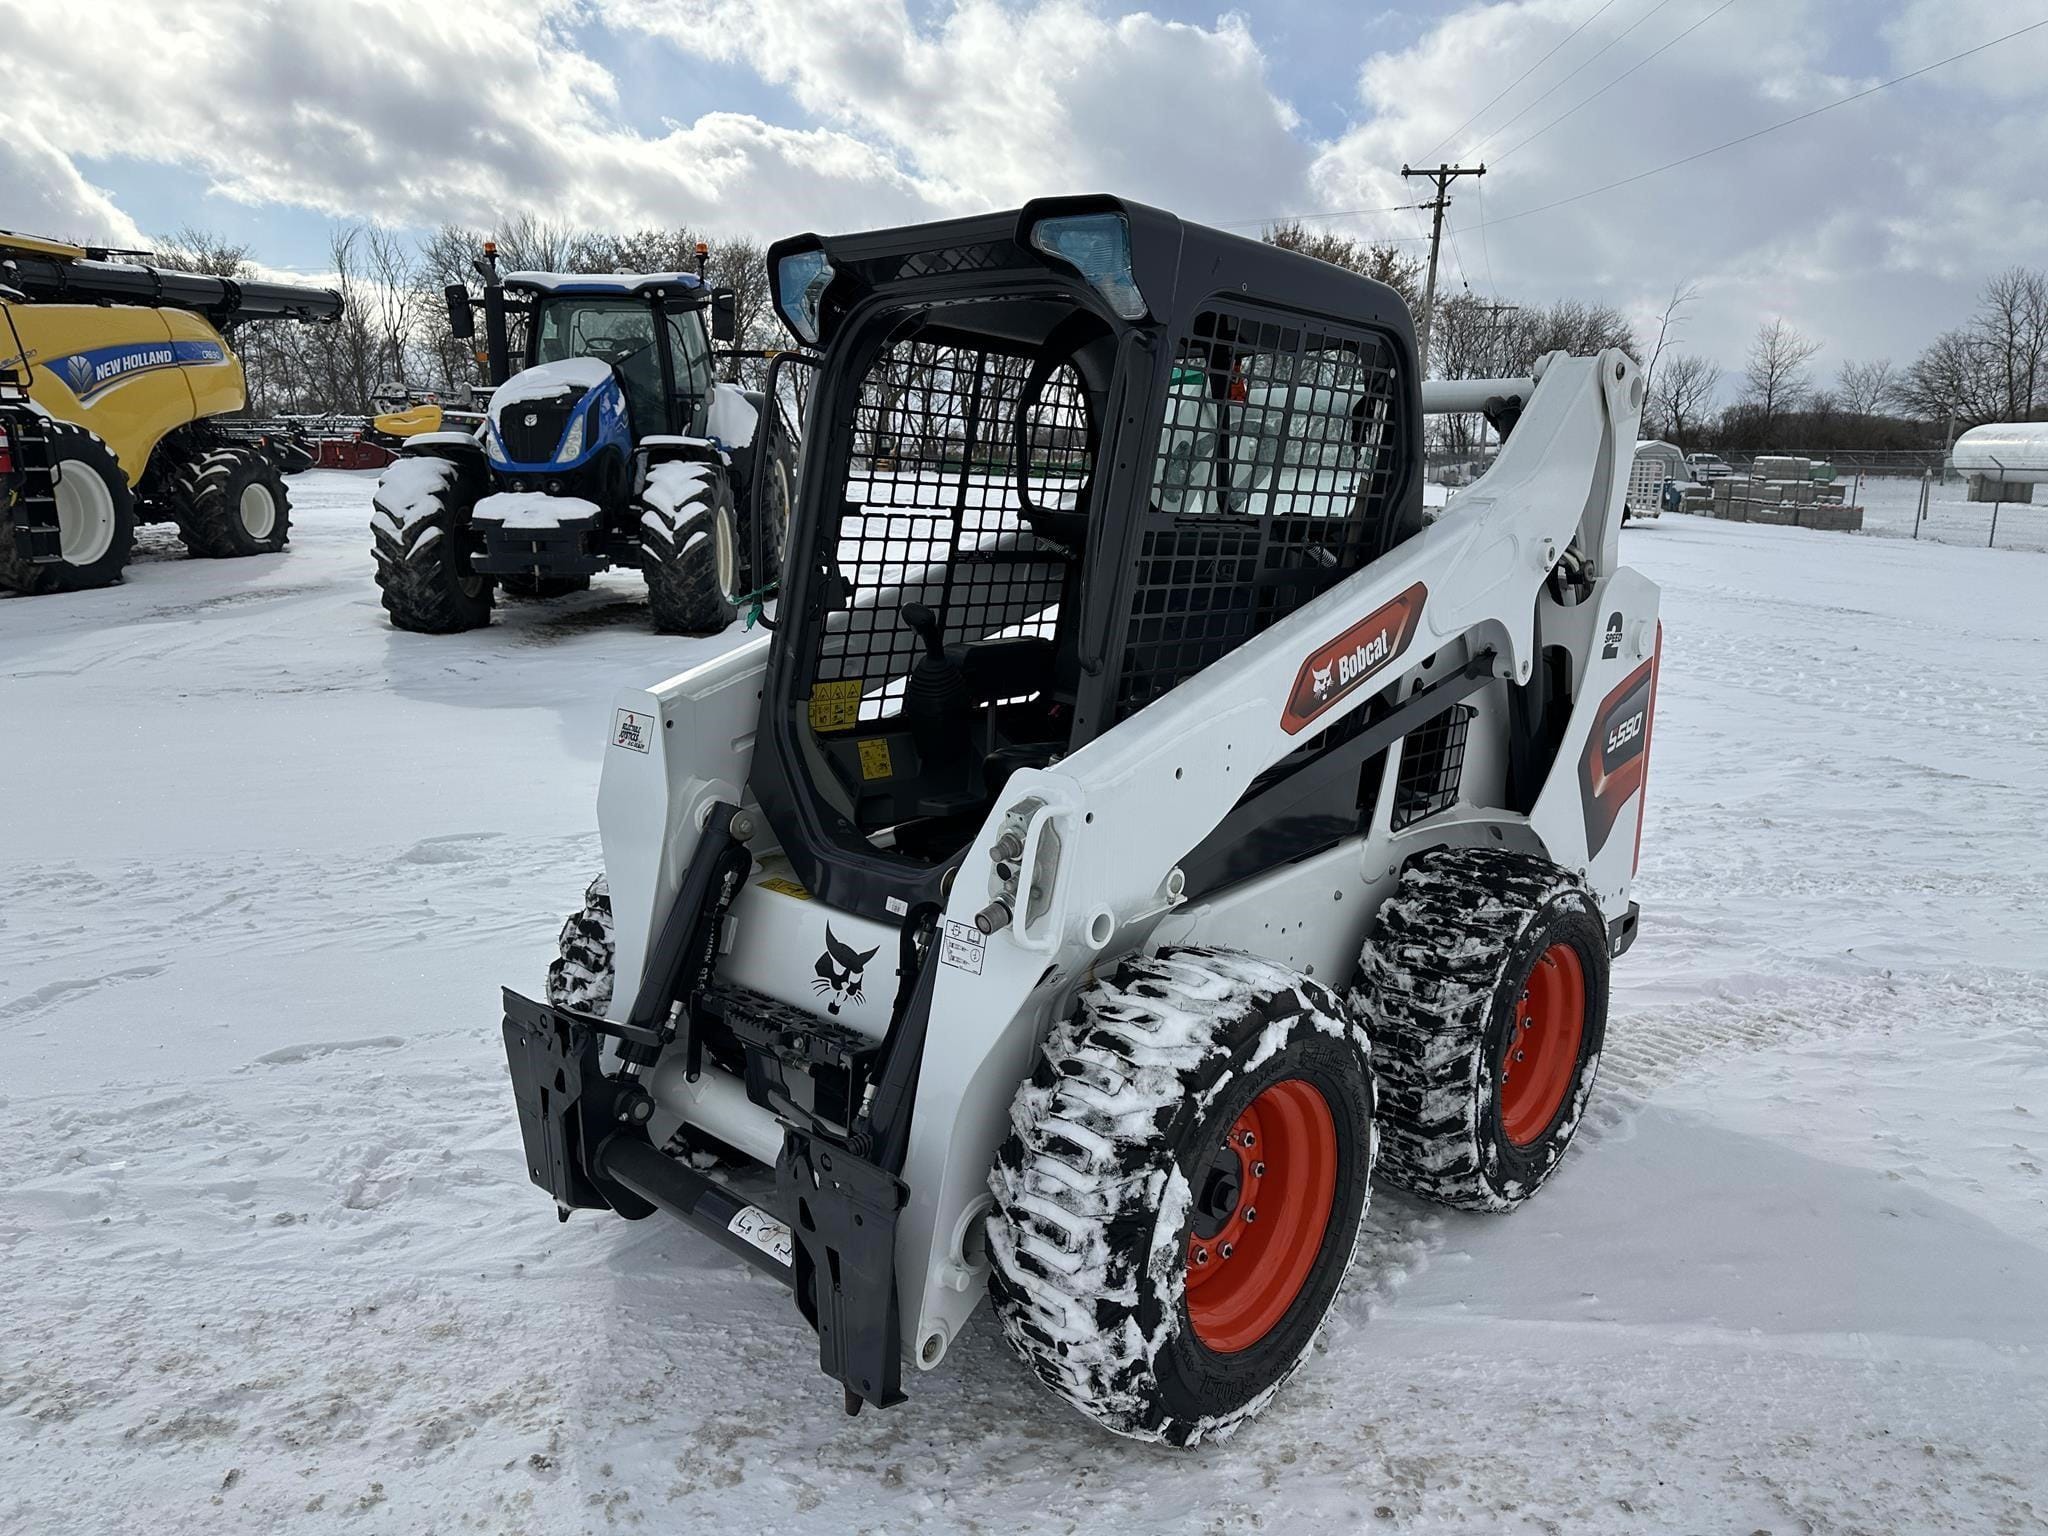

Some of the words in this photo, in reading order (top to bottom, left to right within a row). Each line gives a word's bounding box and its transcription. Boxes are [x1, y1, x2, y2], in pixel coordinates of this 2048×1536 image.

[96, 356, 121, 381] NEW
[123, 350, 172, 370] HOLLAND
[1604, 632, 1623, 643] SPEED
[1338, 627, 1388, 686] Bobcat
[1607, 711, 1643, 754] S590
